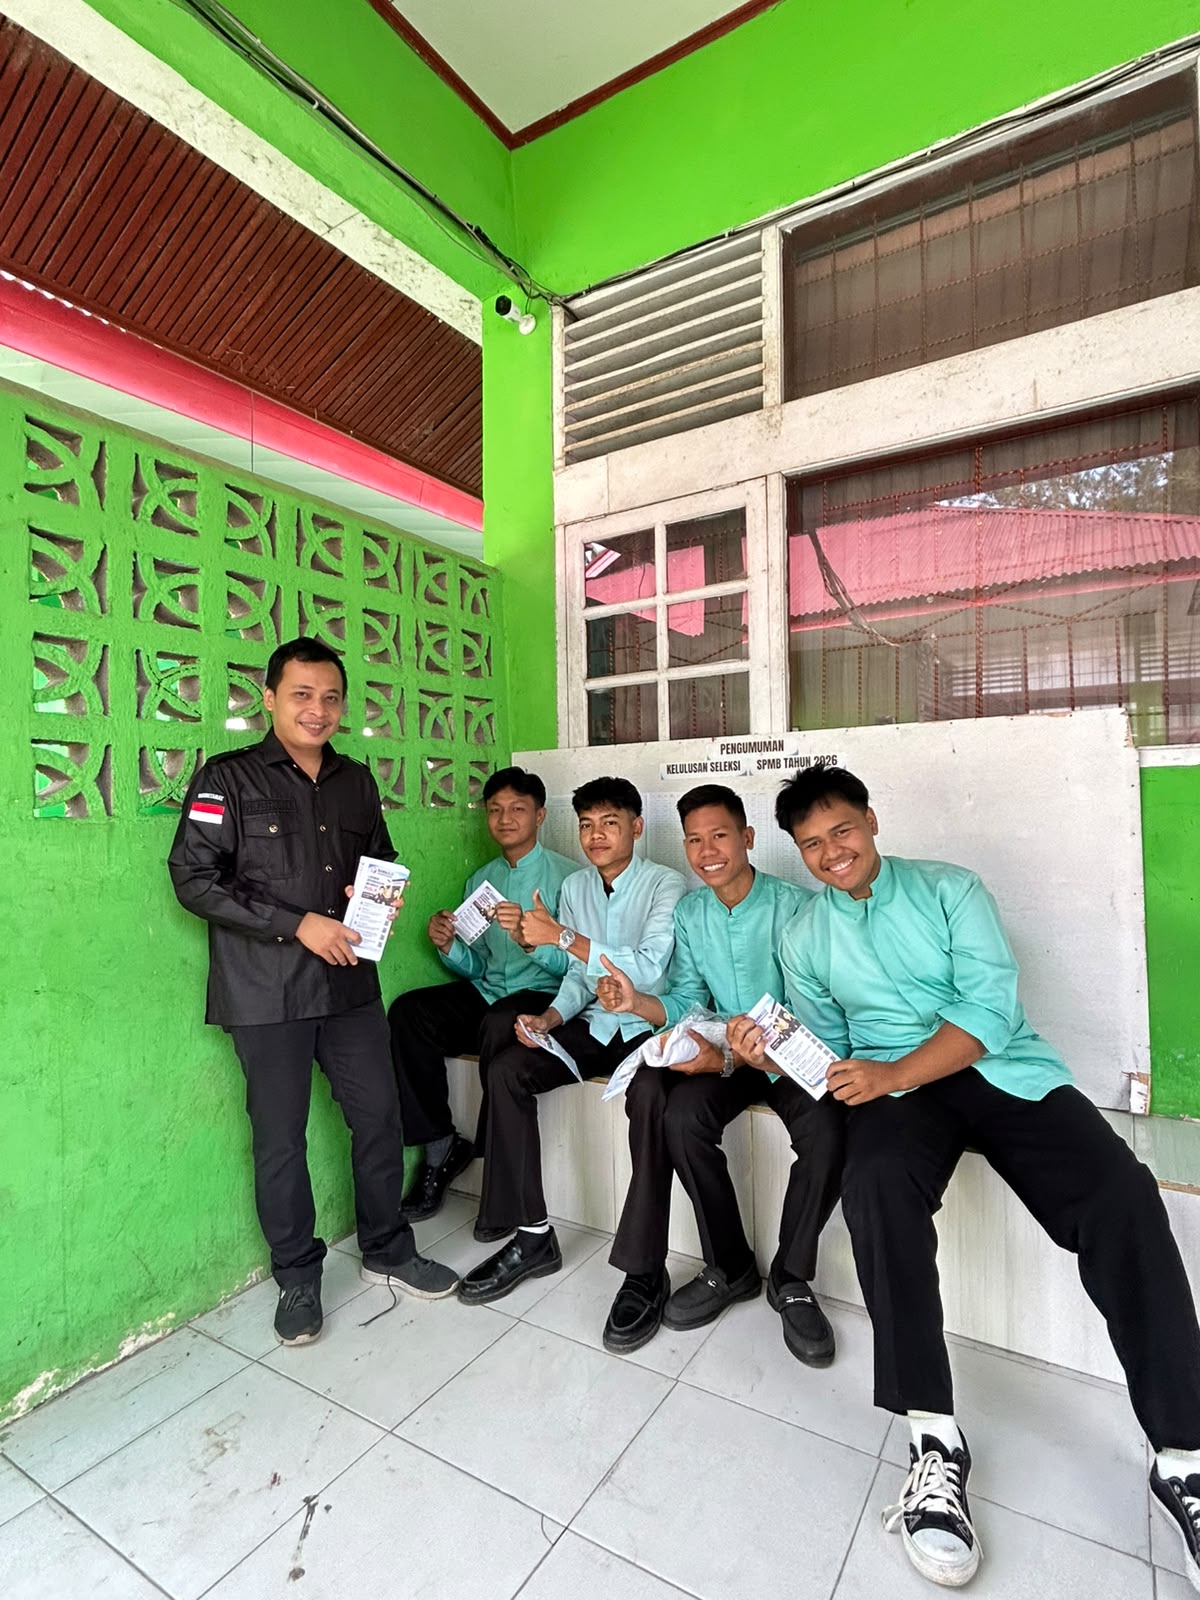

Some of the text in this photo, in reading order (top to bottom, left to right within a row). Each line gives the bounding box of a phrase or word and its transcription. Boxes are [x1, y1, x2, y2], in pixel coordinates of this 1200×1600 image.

[720, 740, 784, 755] PENGUMUMAN
[666, 754, 838, 775] KELULUSAN SELEKSI SPMB TAHUN 2026
